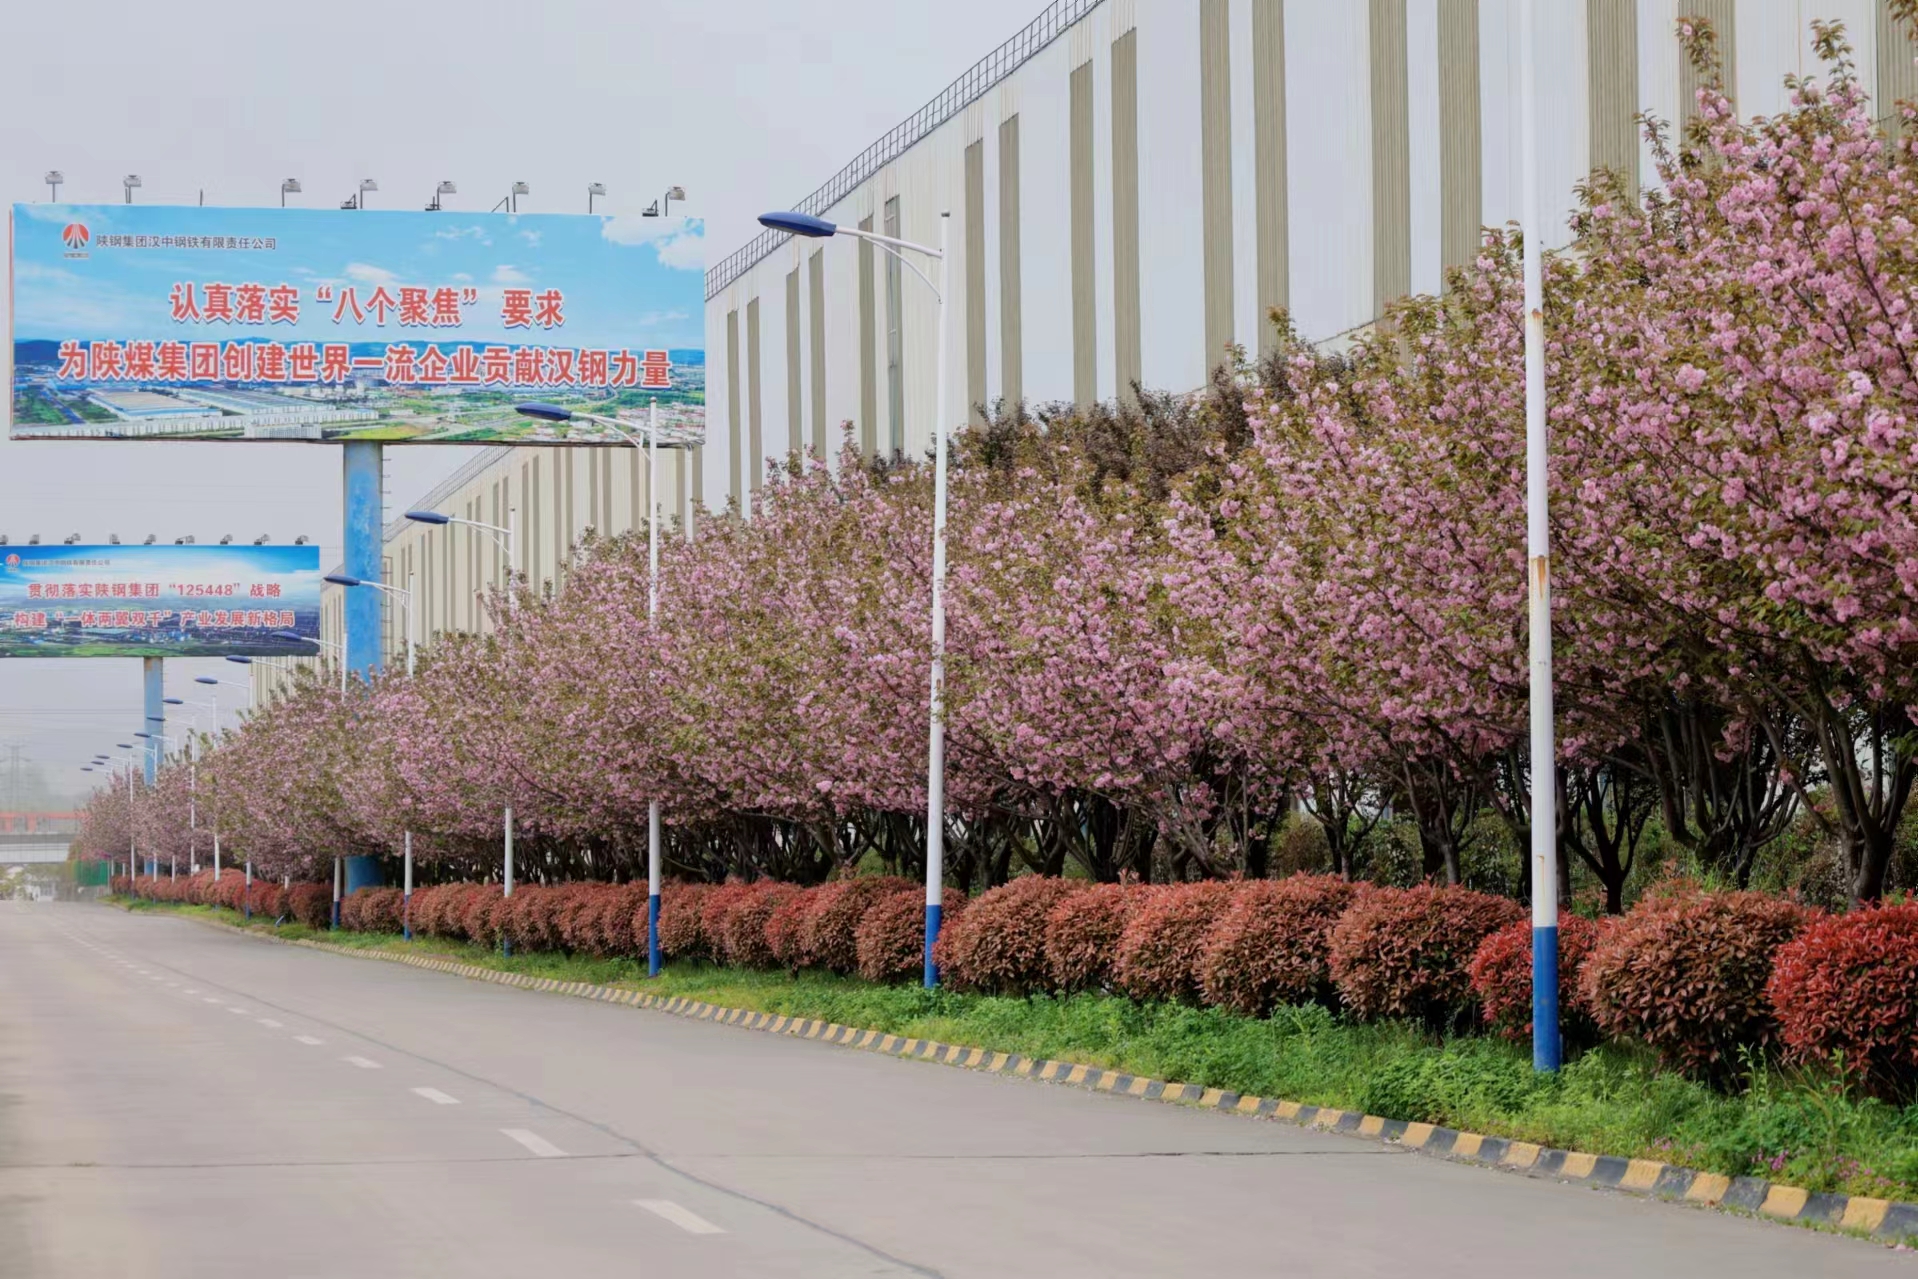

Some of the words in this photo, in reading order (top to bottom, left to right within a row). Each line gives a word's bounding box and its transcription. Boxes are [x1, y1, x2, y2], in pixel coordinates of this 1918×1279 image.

[96, 234, 277, 250] 陕钢集团汉中钢铁有限责任公司
[57, 341, 671, 383] 为陕煤集团创建世界一流企业贡献汉钢力量
